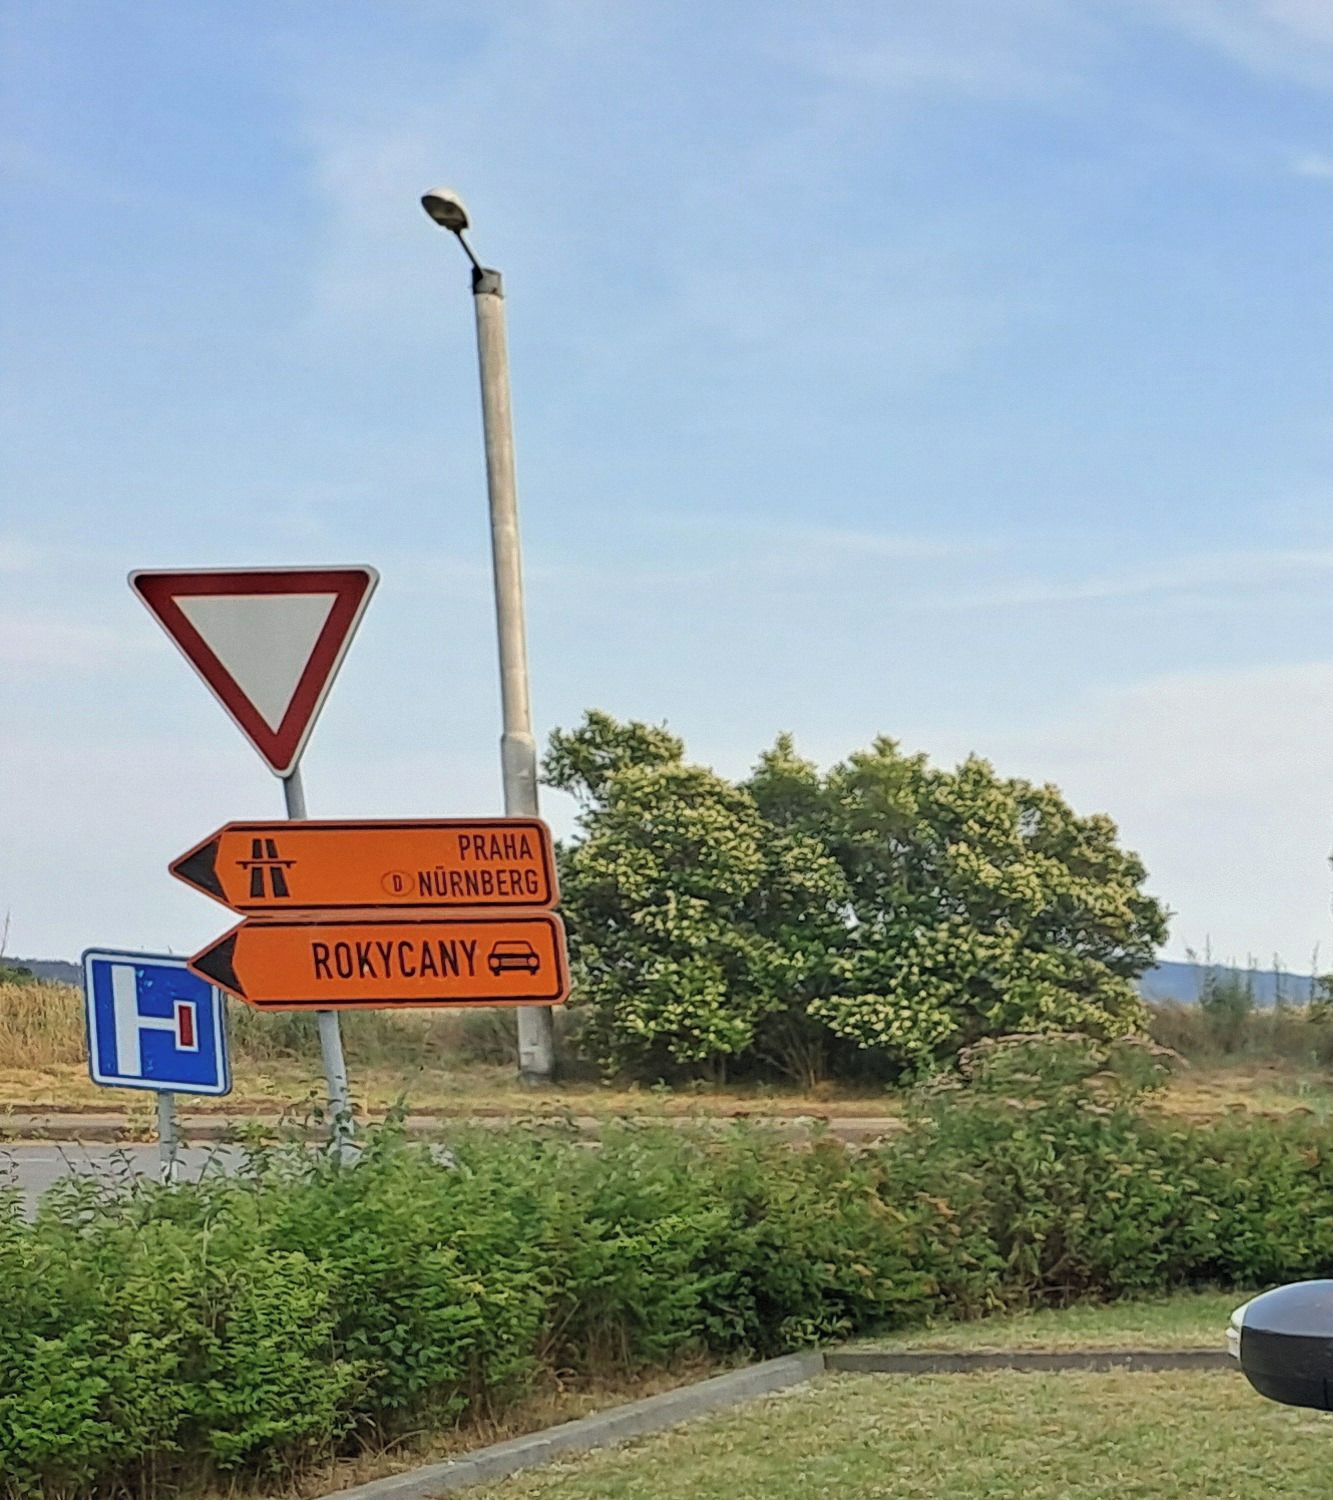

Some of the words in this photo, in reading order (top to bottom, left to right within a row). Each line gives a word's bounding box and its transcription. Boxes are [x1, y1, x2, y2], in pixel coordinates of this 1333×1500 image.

[458, 833, 533, 861] PRAHA
[392, 873, 403, 892] D
[418, 865, 539, 897] NÜRNBERG
[312, 939, 478, 980] ROKYCANY
